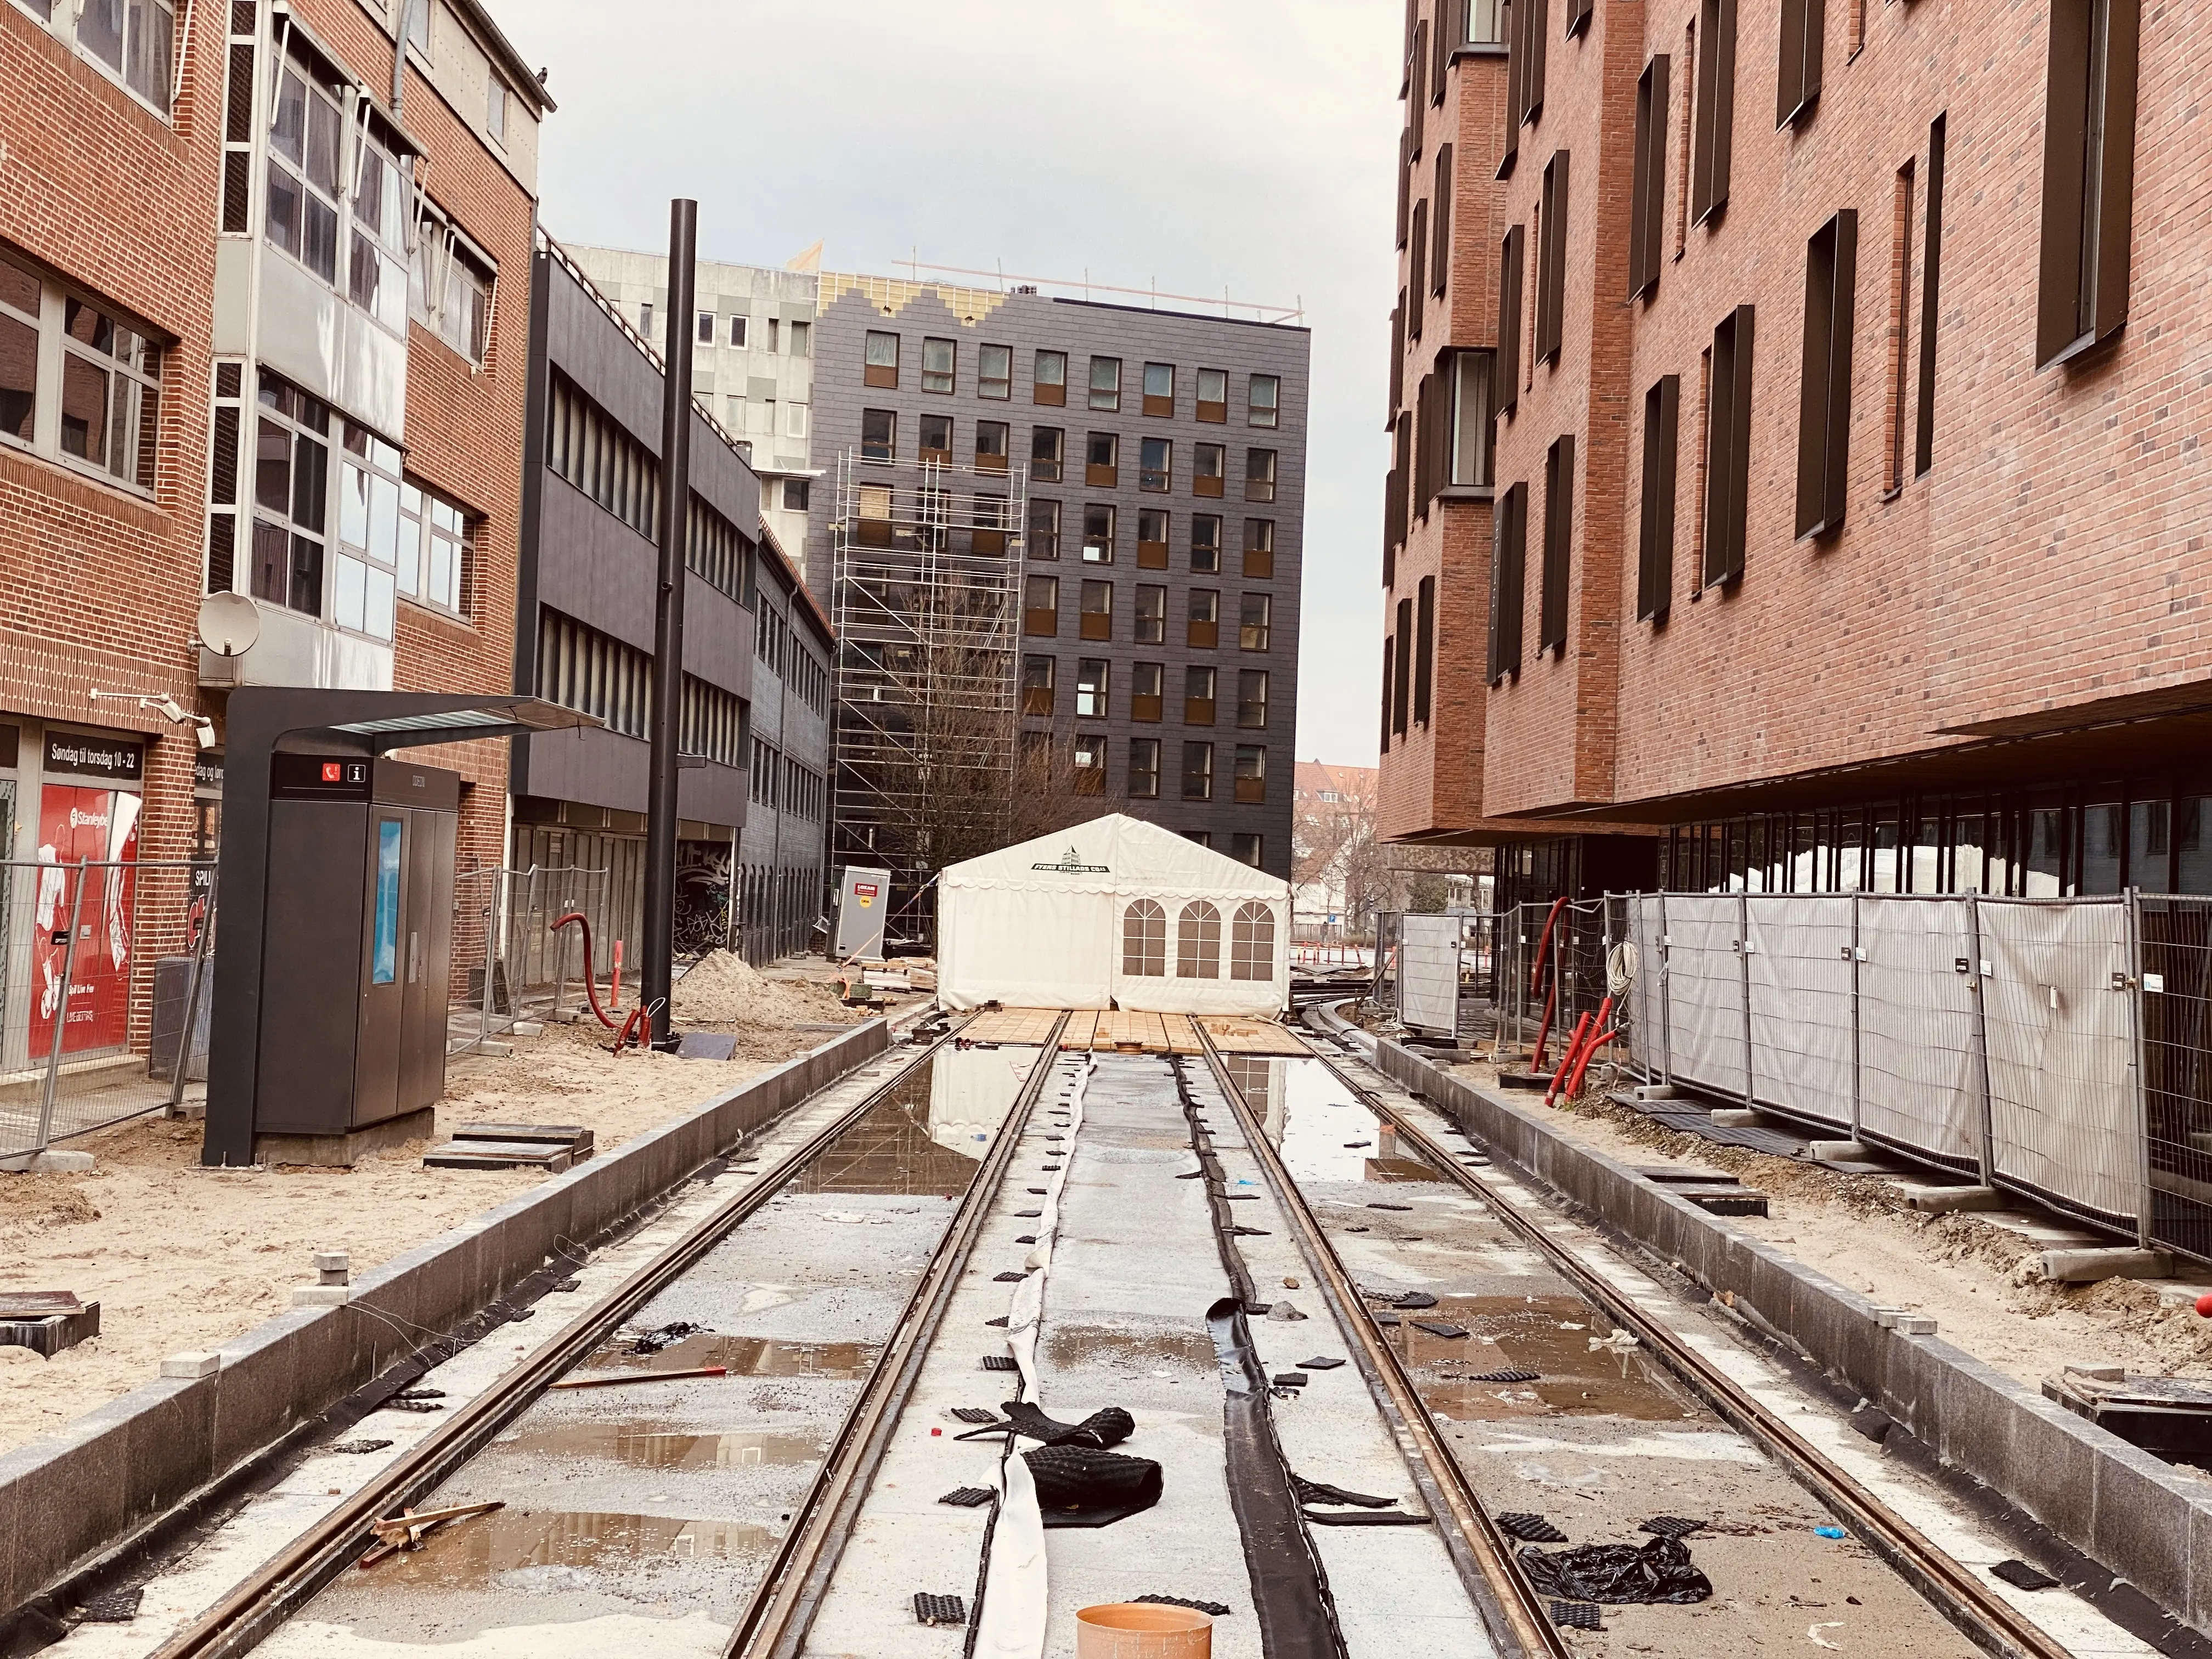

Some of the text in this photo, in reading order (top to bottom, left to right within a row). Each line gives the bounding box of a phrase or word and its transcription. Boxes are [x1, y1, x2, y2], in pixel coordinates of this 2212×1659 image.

[52, 743, 78, 766] Søndag
[87, 749, 113, 770] torsdag
[114, 751, 122, 767] 10
[126, 753, 134, 768] 22
[207, 767, 214, 782] og
